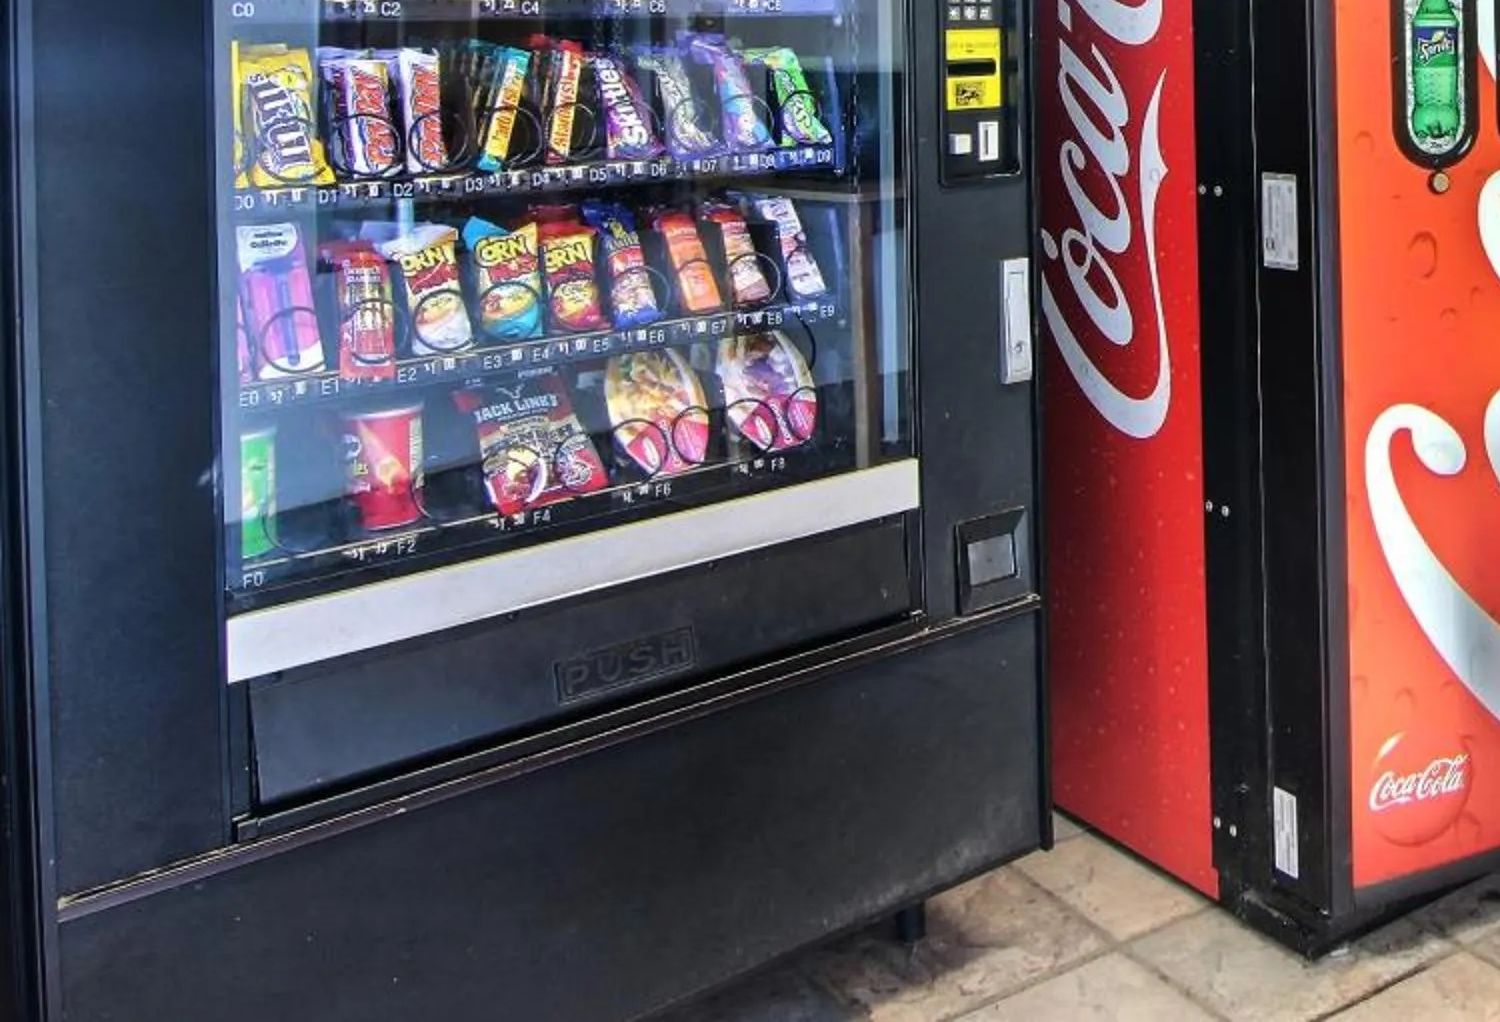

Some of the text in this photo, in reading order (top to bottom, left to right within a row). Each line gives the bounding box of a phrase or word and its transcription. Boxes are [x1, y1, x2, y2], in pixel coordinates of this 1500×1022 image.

[231, 2, 255, 18] C0
[381, 1, 401, 17] C2
[521, 0, 540, 15] C4
[1417, 38, 1455, 65] Sprite
[595, 57, 650, 147] Skittles
[816, 149, 831, 164] D9
[651, 162, 667, 177] D6
[701, 158, 717, 173] D7
[589, 168, 608, 183] D5
[393, 182, 413, 197] D2
[465, 176, 483, 191] D3
[319, 189, 338, 204] D1
[819, 303, 835, 318] E9
[711, 320, 727, 335] E7
[649, 329, 665, 344] E6
[593, 337, 609, 353] E5
[483, 354, 501, 369] E3
[532, 347, 549, 363] E4
[397, 368, 417, 383] E2
[321, 380, 339, 394] E1
[239, 390, 259, 405] E0
[473, 401, 514, 424] JACK
[654, 484, 672, 498] F6
[532, 508, 551, 523] F4
[397, 539, 416, 555] F2
[243, 573, 264, 588] F0
[564, 629, 691, 695] PUSH
[1369, 753, 1470, 812] Coca-Cola
